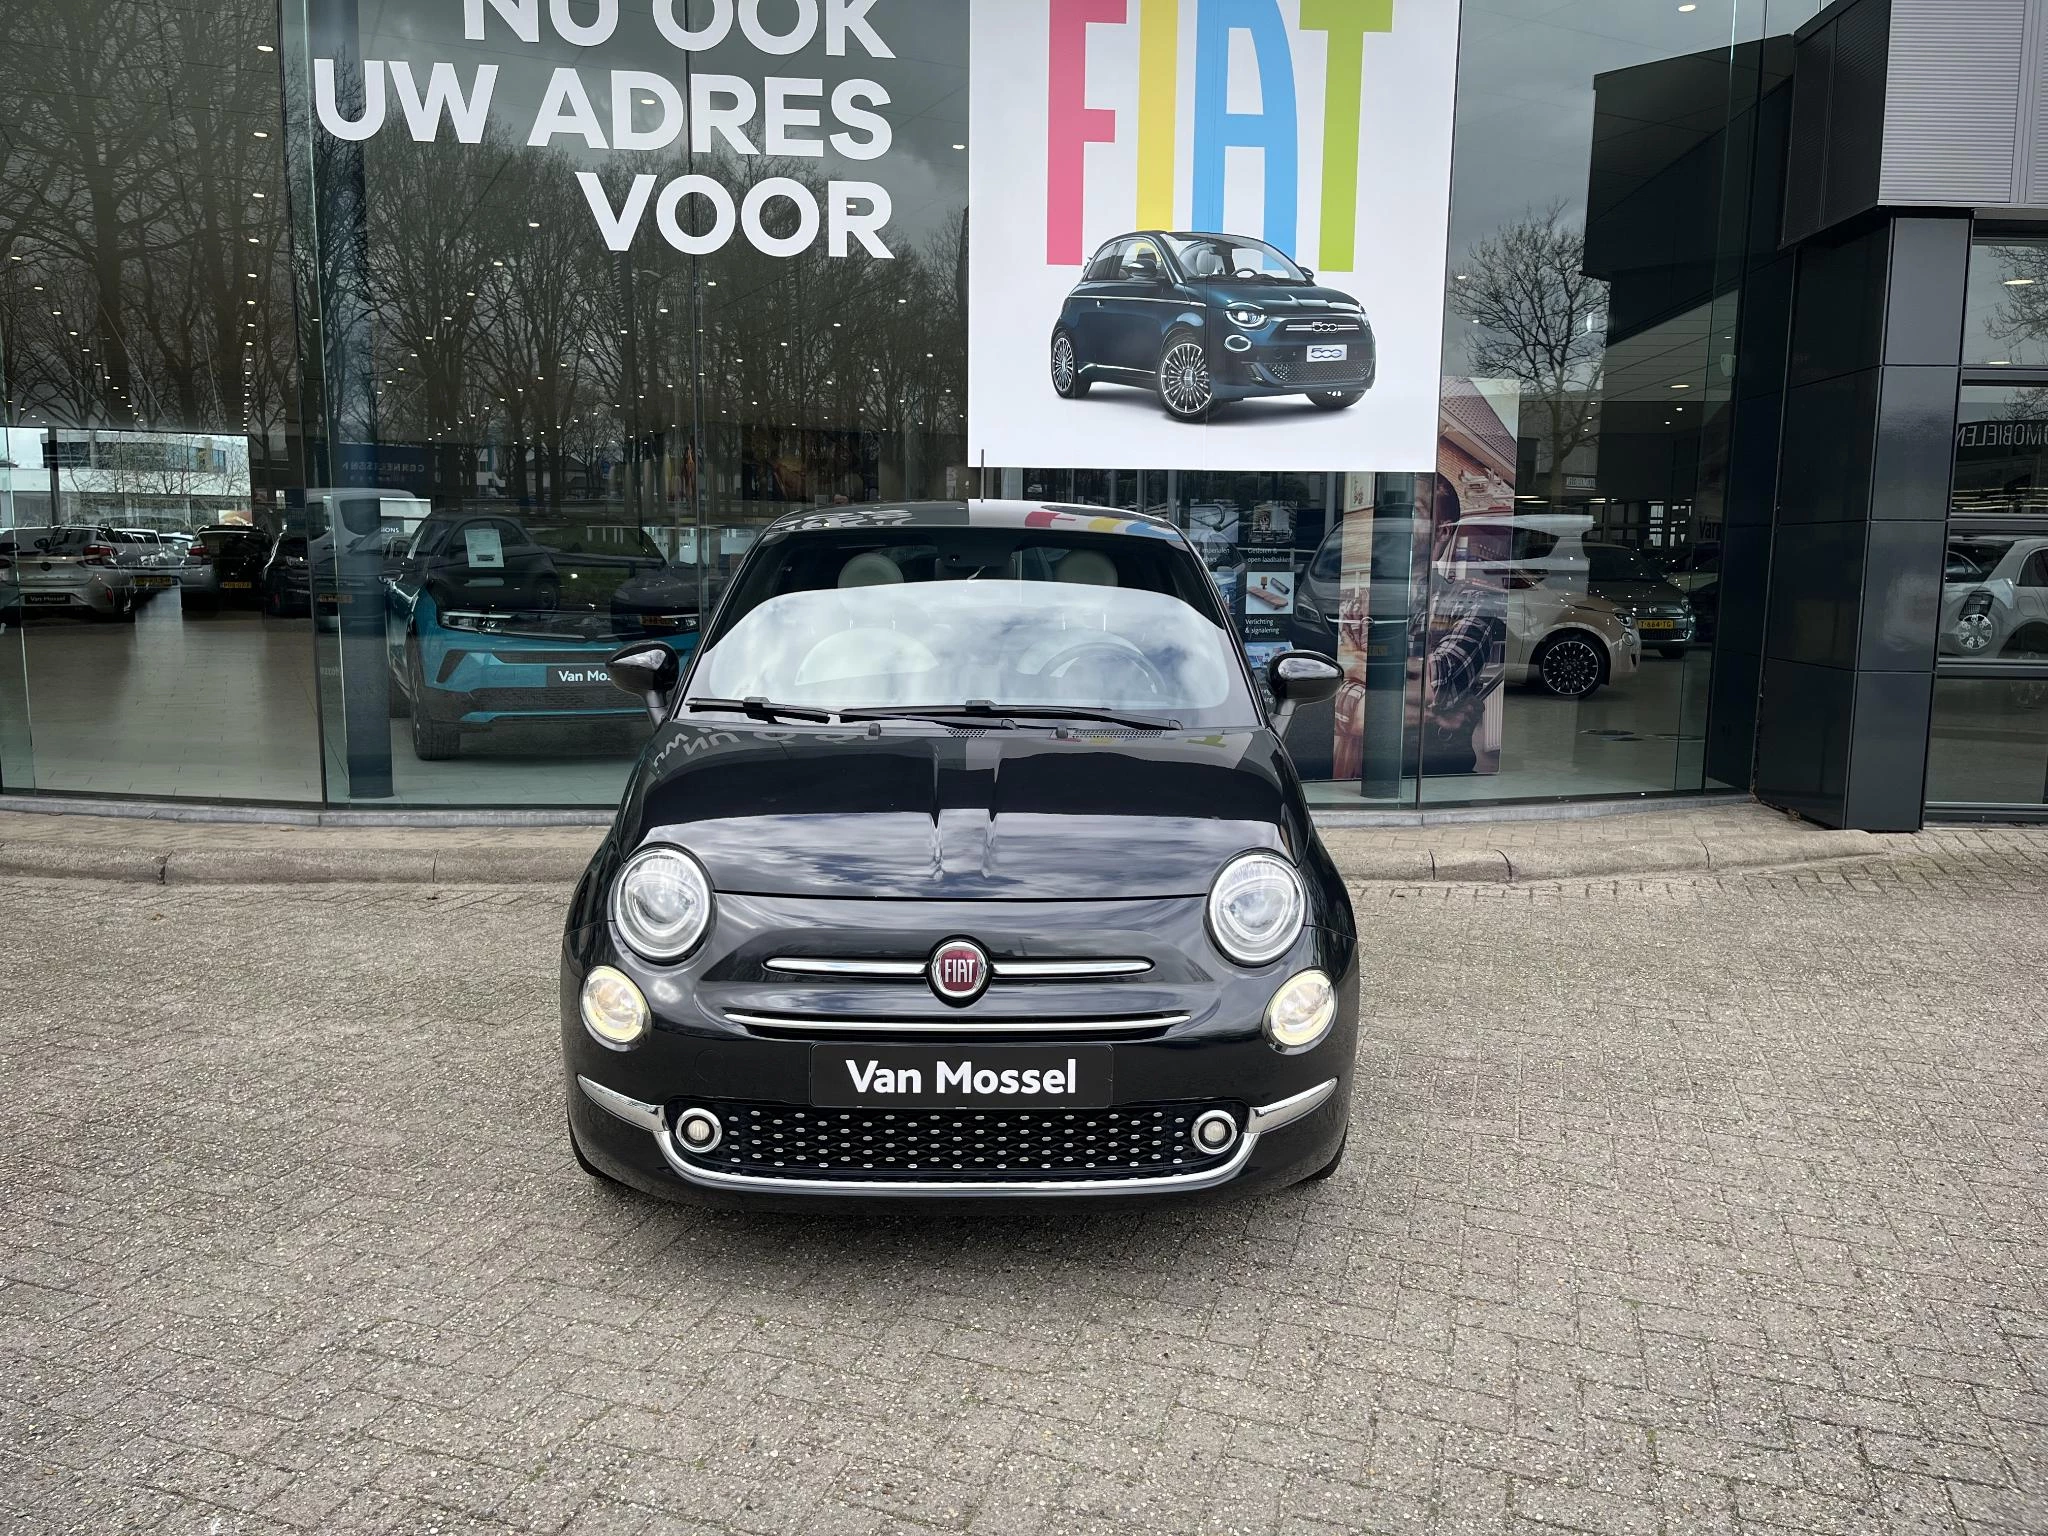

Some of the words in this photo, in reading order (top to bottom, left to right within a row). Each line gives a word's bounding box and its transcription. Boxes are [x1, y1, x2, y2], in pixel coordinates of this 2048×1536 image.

[653, 0, 895, 59] OOK
[313, 58, 499, 144] UW
[526, 67, 893, 160] ADRES
[1047, 0, 1393, 273] FIAT
[574, 171, 895, 259] VOOR
[1311, 347, 1342, 359] 500
[558, 670, 584, 682] Van
[587, 670, 612, 682] Mo
[944, 958, 976, 983] FIAT
[845, 1059, 922, 1094] Van
[936, 1058, 1077, 1094] Mossel
